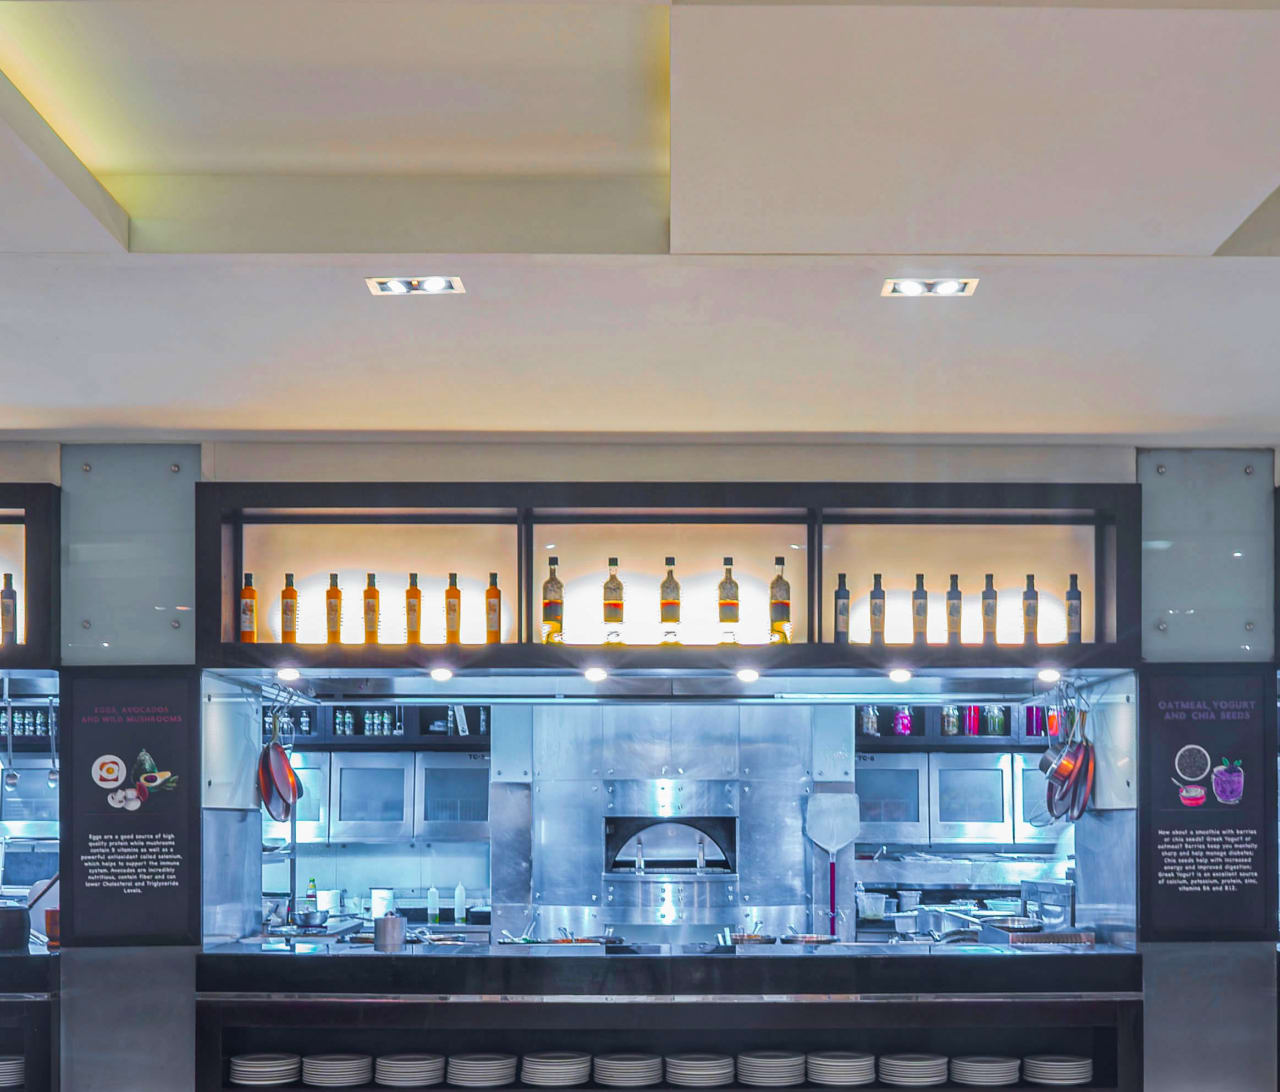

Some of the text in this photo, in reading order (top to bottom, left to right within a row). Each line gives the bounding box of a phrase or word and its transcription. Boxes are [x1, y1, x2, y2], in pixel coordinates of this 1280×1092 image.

[1213, 701, 1256, 710] YOGURT
[1164, 711, 1250, 720] AND CHIA SEEDS
